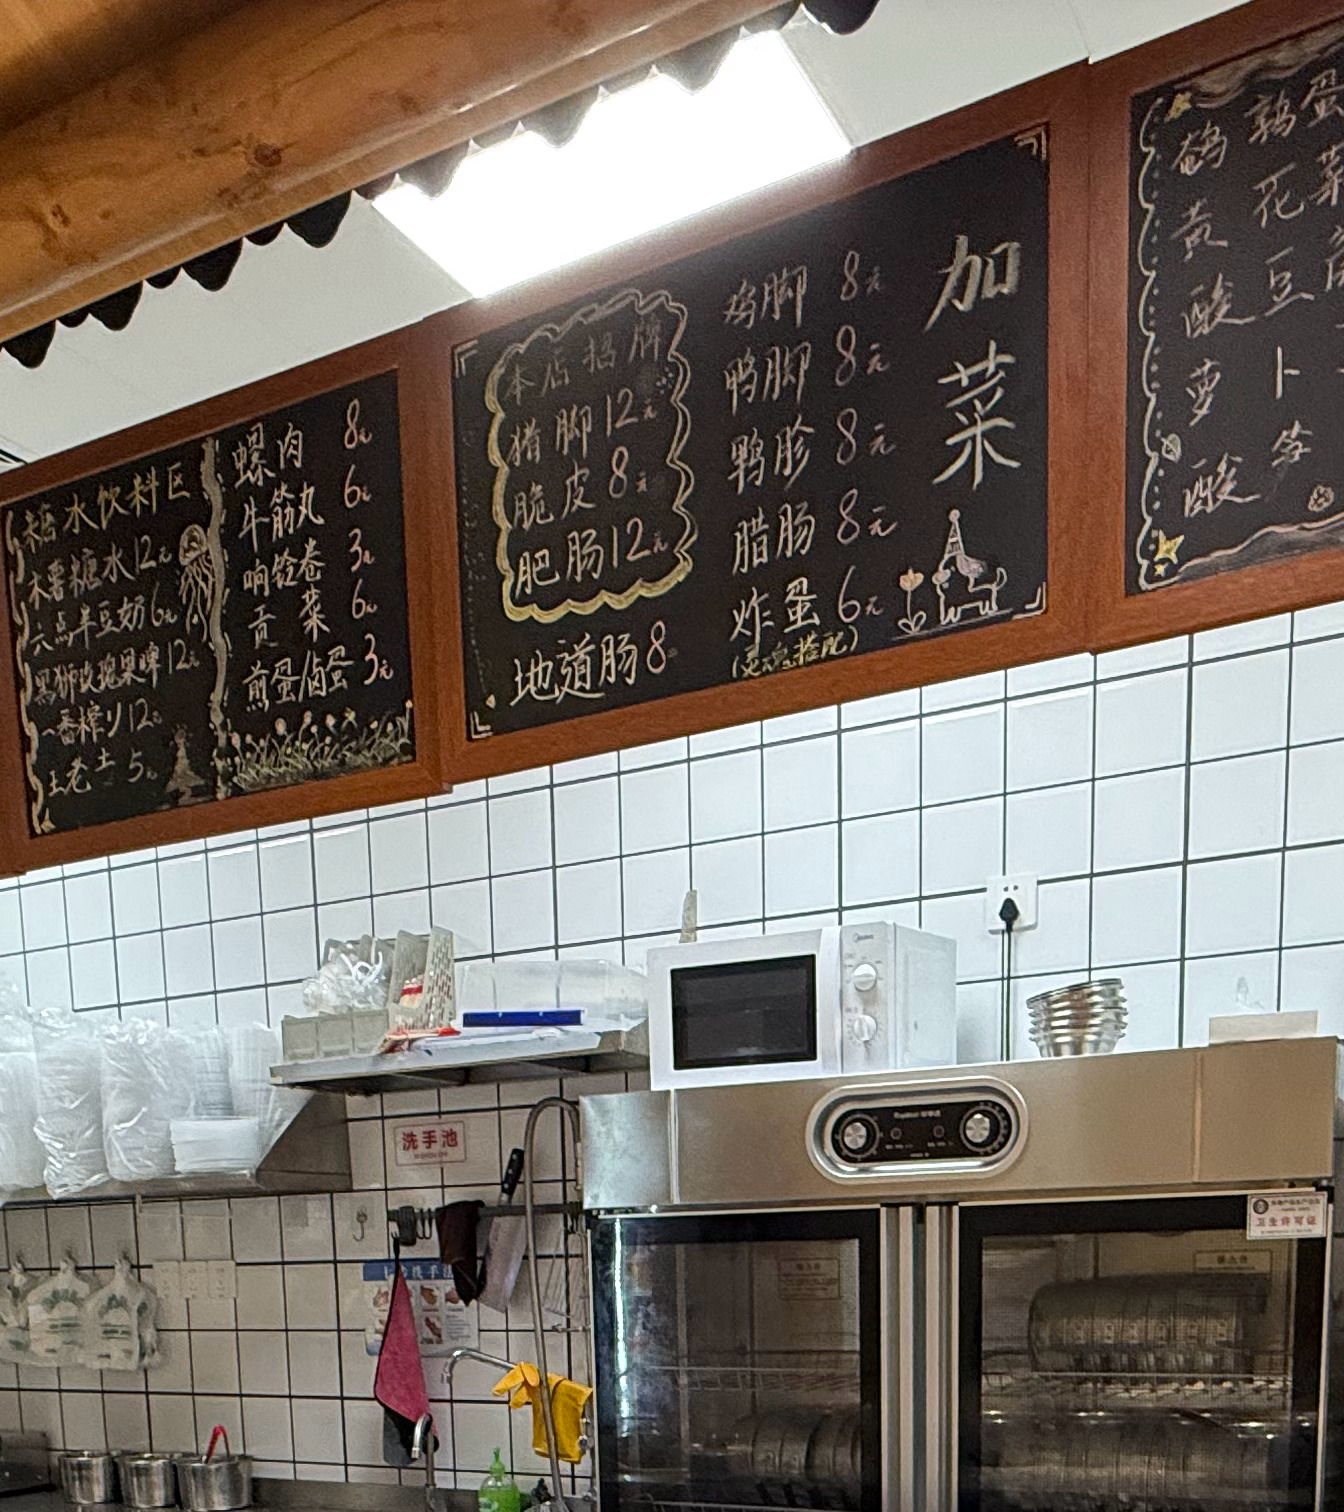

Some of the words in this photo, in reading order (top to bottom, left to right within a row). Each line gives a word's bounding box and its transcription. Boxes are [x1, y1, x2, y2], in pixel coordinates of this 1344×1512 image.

[925, 234, 1022, 491] 加菜
[402, 1128, 459, 1151] 洗手池
